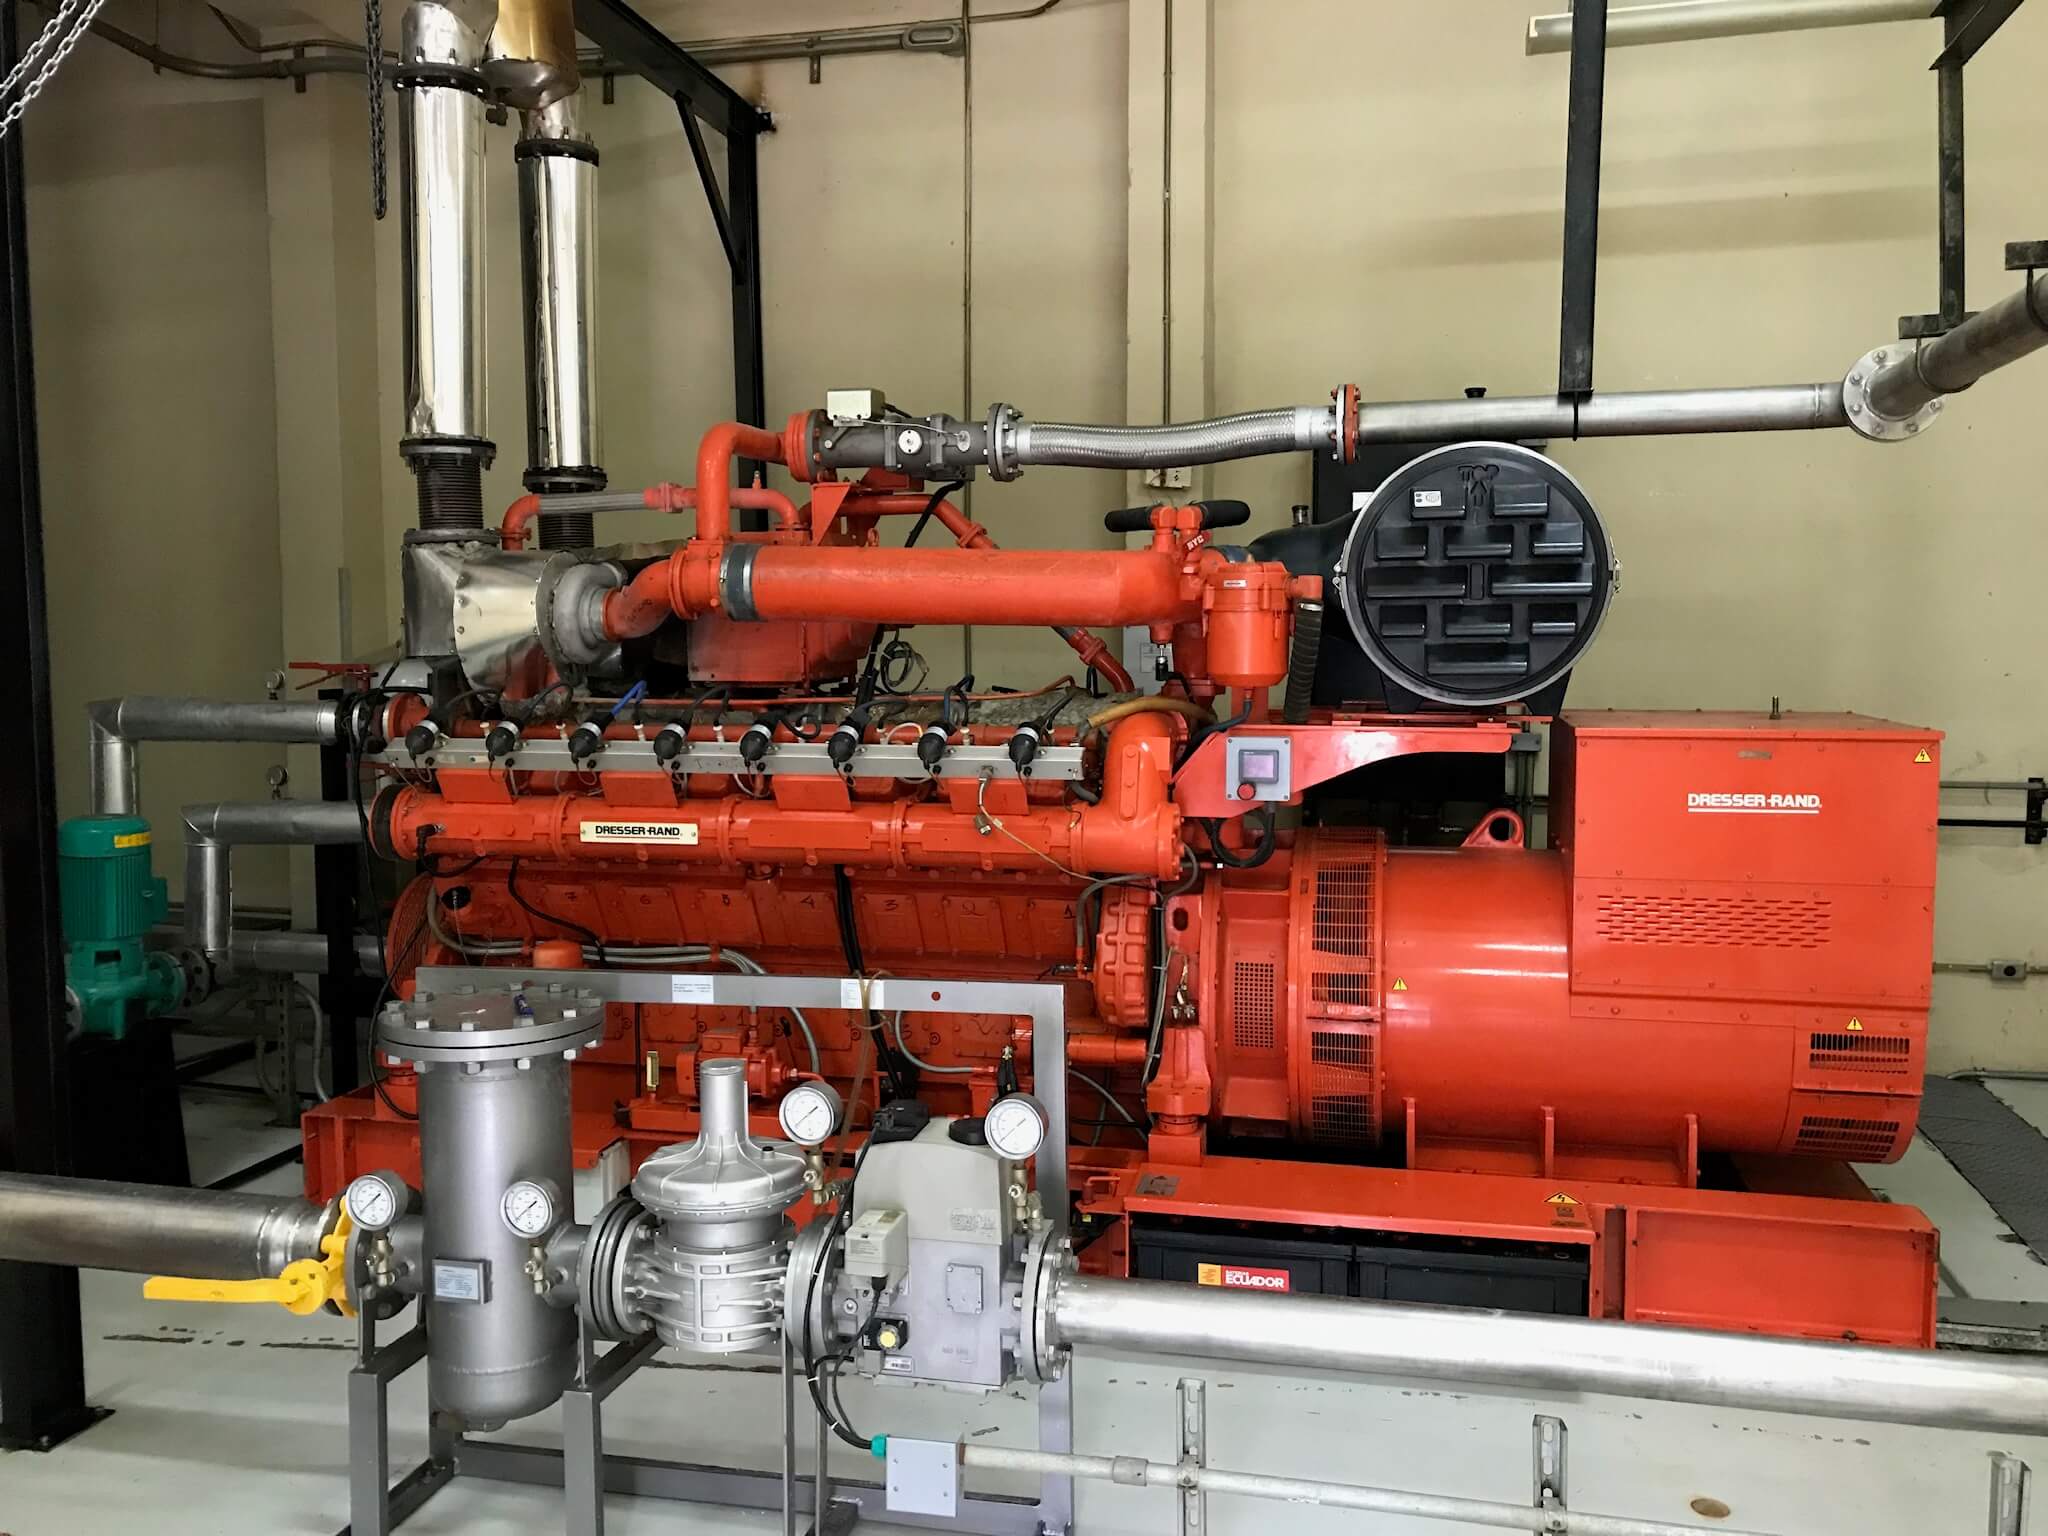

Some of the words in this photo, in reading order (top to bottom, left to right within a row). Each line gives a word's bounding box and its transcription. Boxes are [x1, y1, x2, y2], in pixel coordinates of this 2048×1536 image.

[1457, 464, 1500, 481] TOP
[1687, 793, 1822, 808] DRESSER-RAND
[595, 825, 680, 836] DRESSER-RAND
[1225, 1273, 1284, 1289] ECUADOR
